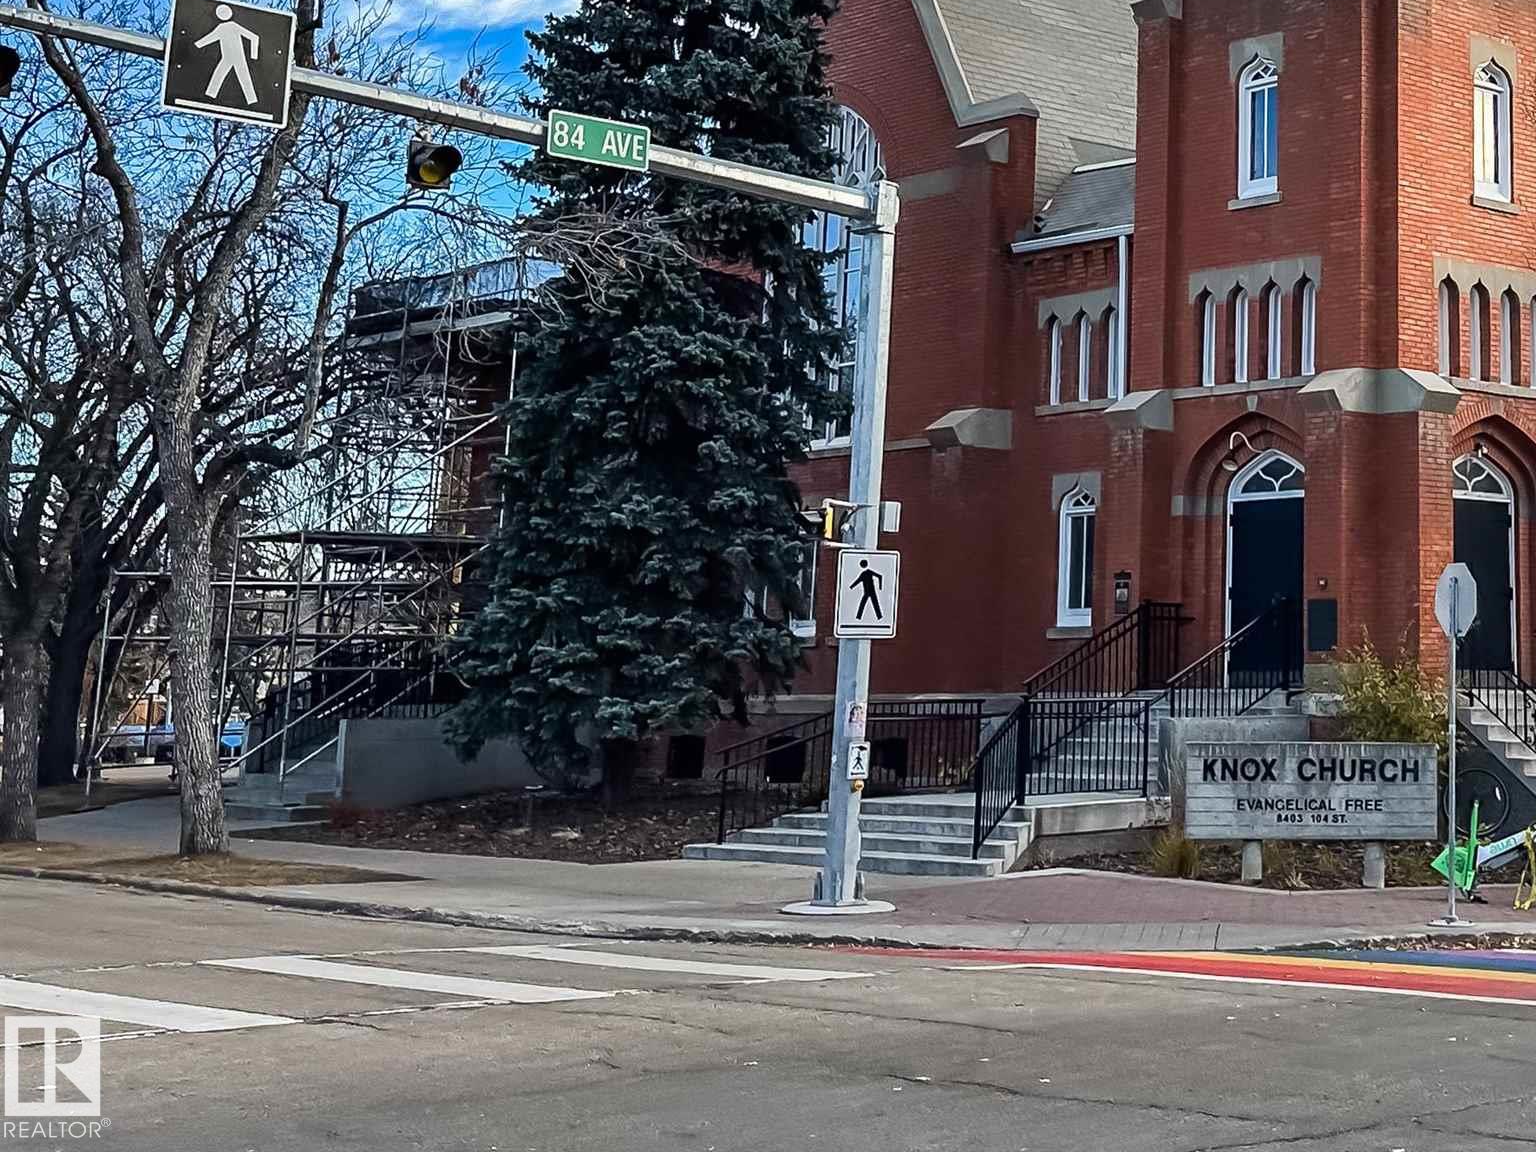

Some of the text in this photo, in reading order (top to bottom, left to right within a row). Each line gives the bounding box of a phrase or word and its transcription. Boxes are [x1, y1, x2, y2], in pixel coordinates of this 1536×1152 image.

[553, 120, 645, 161] 84 AVE
[1202, 758, 1420, 782] KNOX CHURCH
[1236, 799, 1384, 811] EVANGELICAL FREE
[1311, 813, 1329, 823] 104
[1331, 813, 1348, 823] ST.
